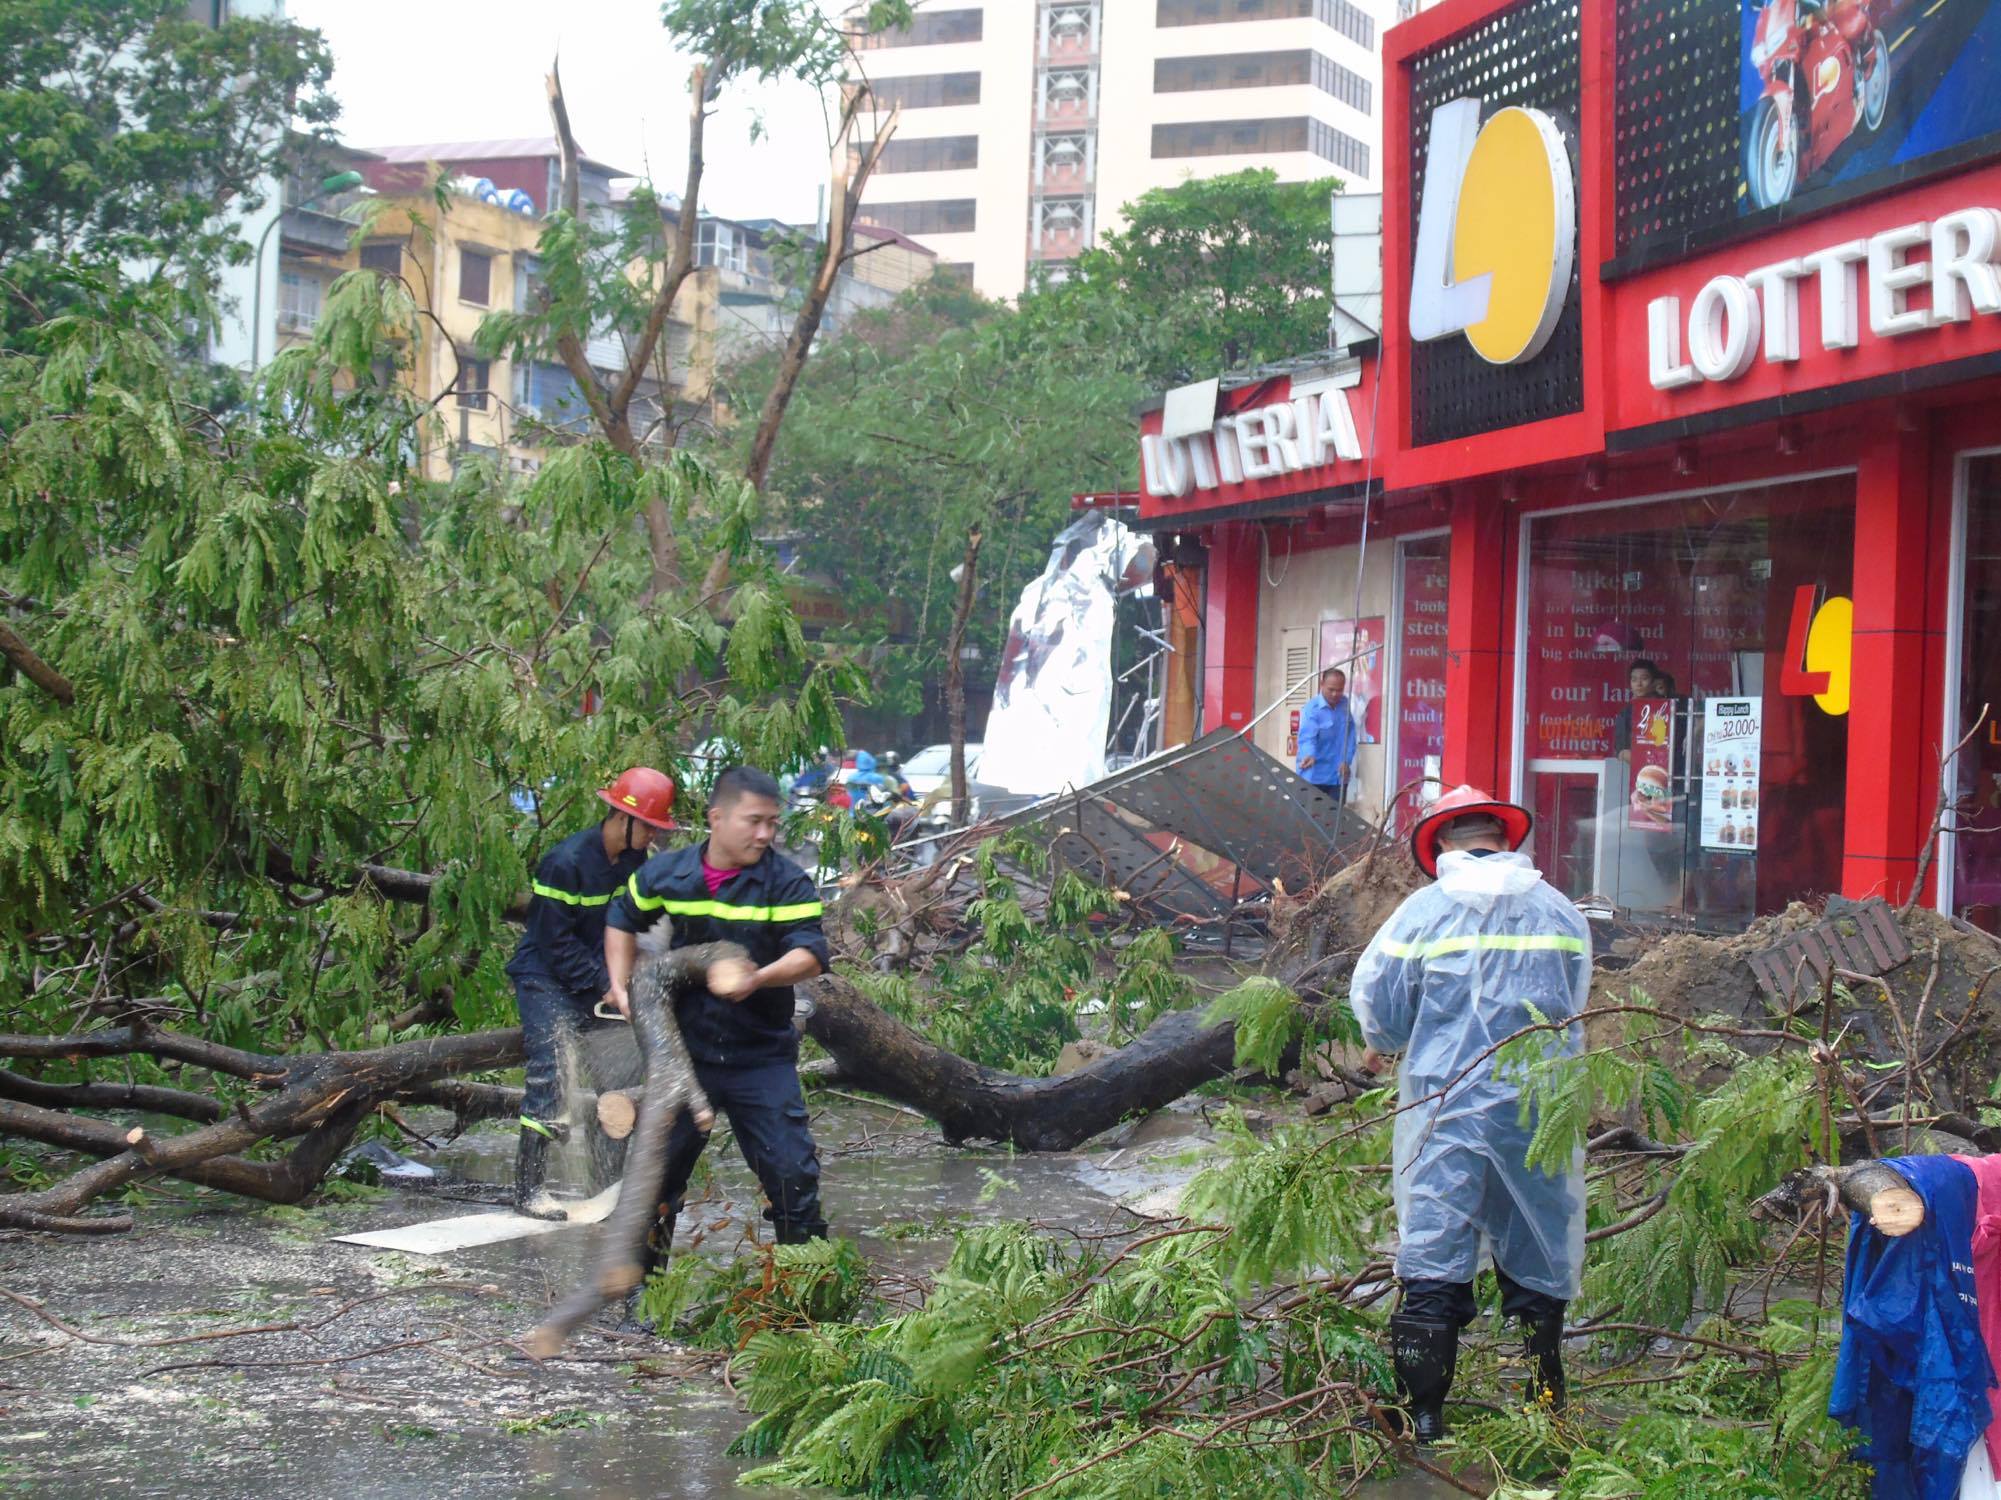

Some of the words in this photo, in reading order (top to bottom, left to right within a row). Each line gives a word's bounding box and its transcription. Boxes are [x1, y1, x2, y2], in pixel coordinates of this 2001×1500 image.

[1547, 622, 1564, 637] in
[1410, 646, 1439, 657] rock
[1541, 647, 1563, 662] big
[1407, 679, 1446, 698] this
[1551, 686, 1591, 702] our
[1550, 736, 1609, 752] diners
